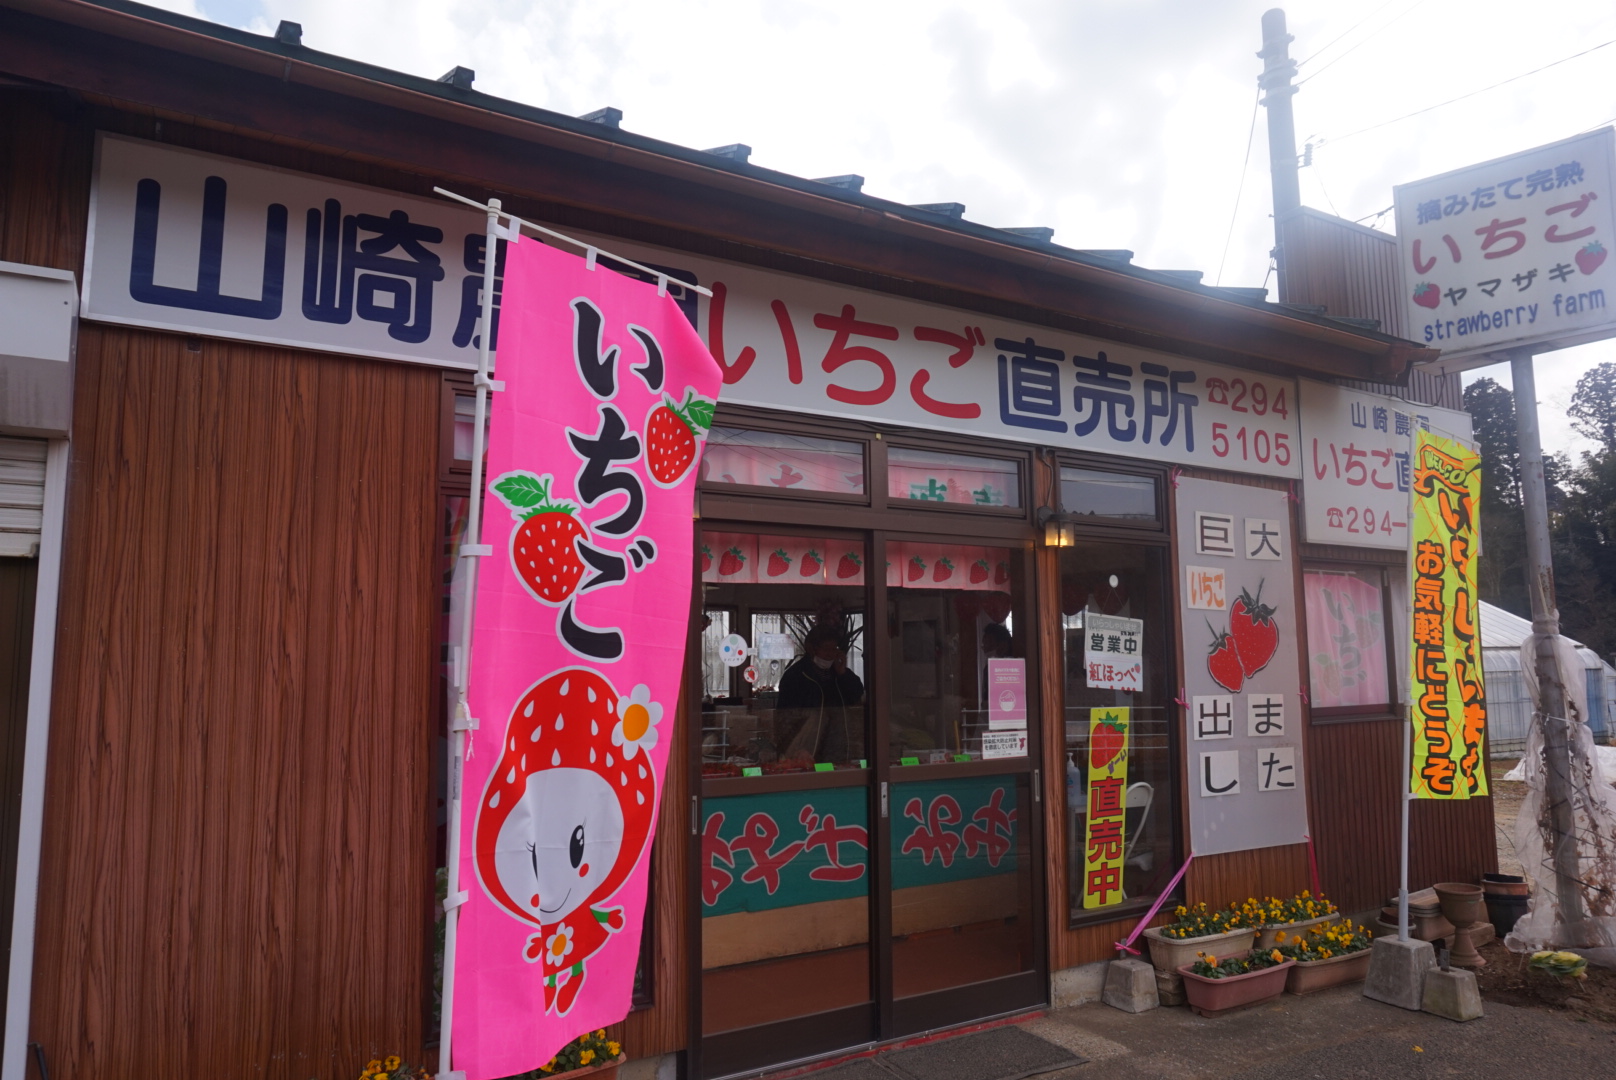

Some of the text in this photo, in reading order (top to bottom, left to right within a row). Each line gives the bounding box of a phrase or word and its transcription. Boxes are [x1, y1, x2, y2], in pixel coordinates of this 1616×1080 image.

[1416, 160, 1585, 225] 摘みたて完熟
[1412, 191, 1598, 275] いちご
[1443, 263, 1575, 306] ヤマザキ
[1424, 288, 1606, 342] strawberry farm
[1212, 422, 1291, 467] 5105
[559, 297, 665, 662] いちご
[1424, 450, 1467, 487] WELCO
[1200, 515, 1281, 557] 巨大
[1191, 571, 1224, 608] いちご
[1091, 633, 1137, 655] 営業中
[1089, 661, 1137, 682] 紅ほっぺ
[1414, 539, 1454, 795] お気軽にどうぞ
[1087, 775, 1125, 906] 直売中
